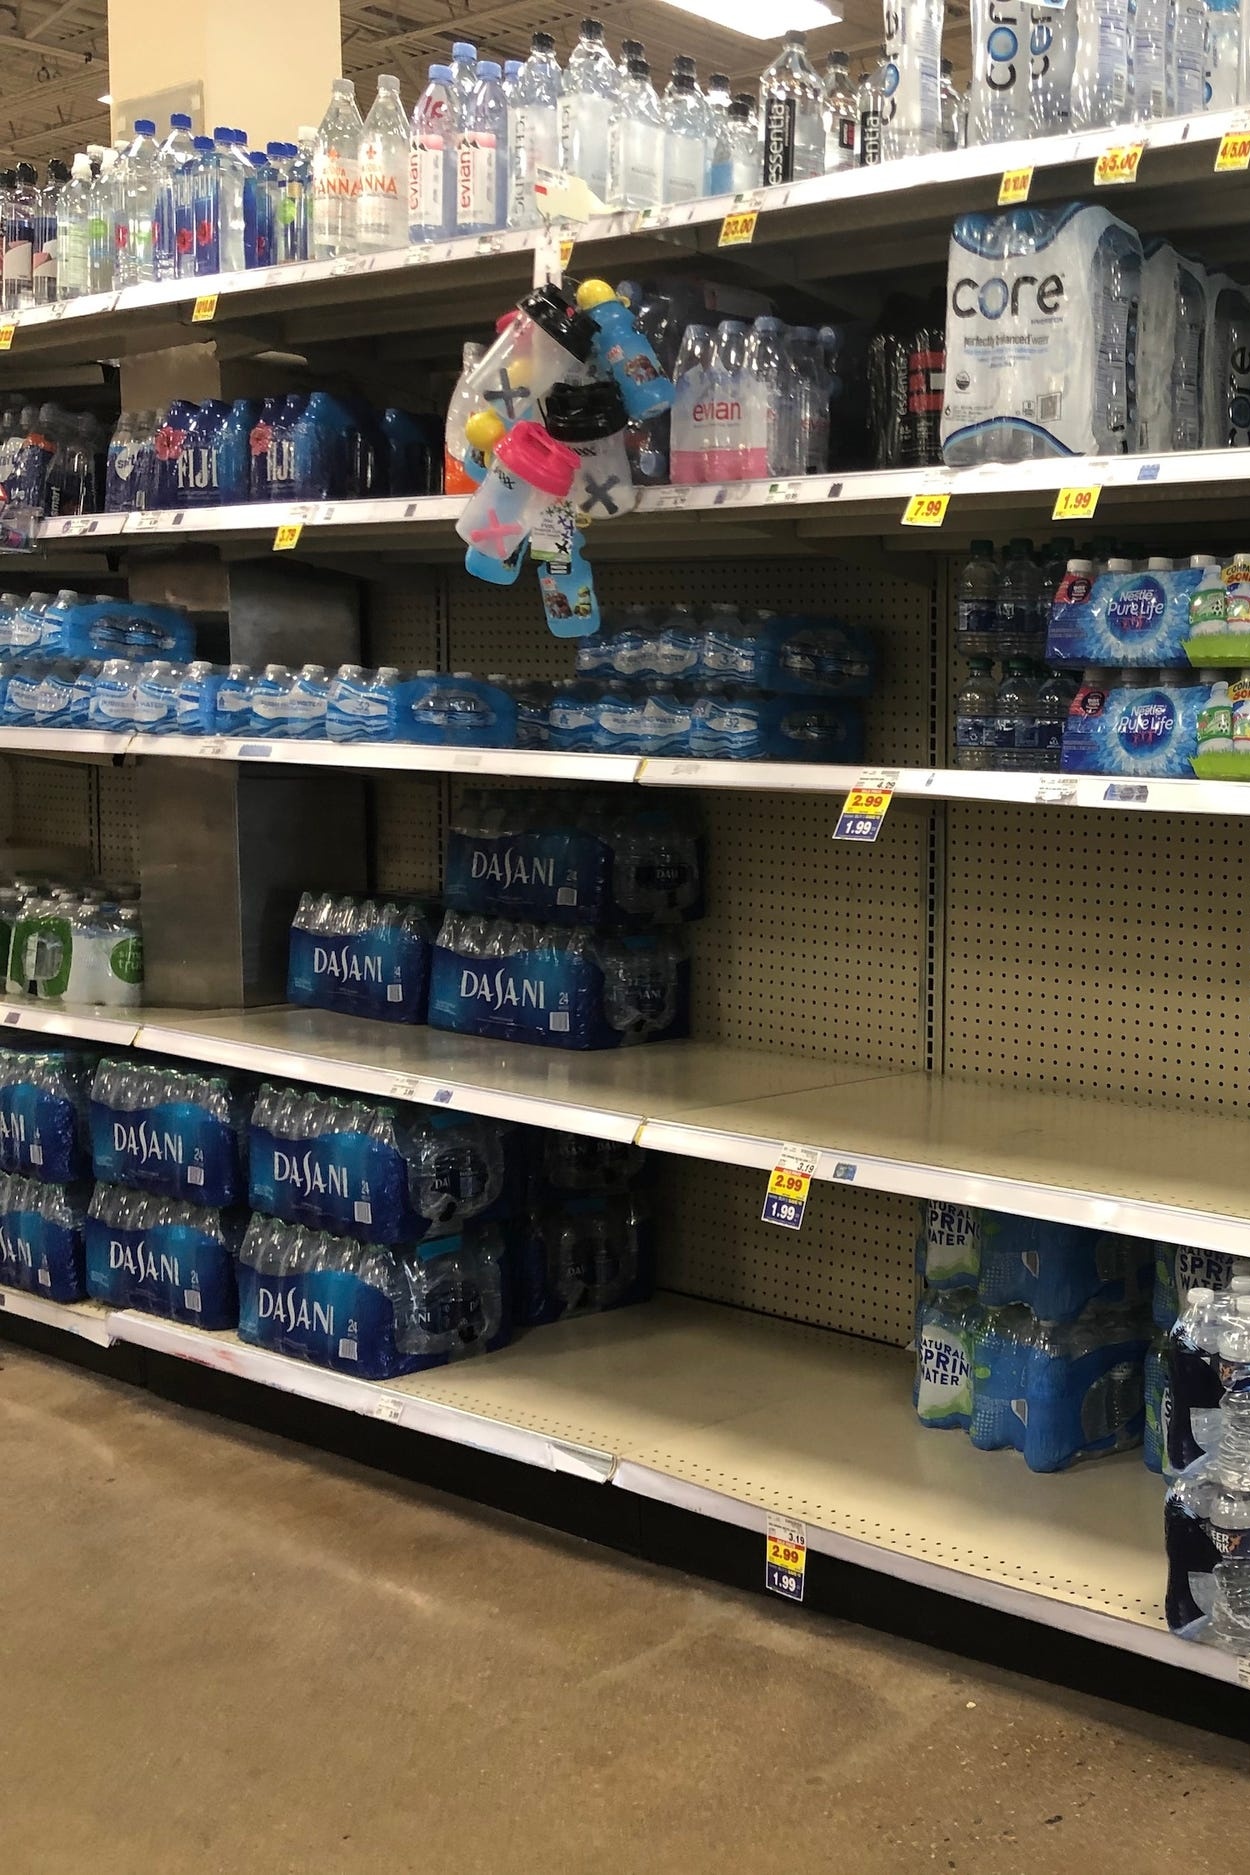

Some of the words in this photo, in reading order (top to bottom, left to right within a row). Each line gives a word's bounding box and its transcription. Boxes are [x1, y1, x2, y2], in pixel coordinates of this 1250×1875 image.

[768, 104, 785, 186] essentia
[1220, 140, 1250, 159] 4/5.00
[1098, 152, 1137, 172] 3/5.00
[460, 151, 471, 208] evian
[952, 274, 1065, 320] core
[692, 398, 741, 422] evian
[177, 448, 219, 488] FIJI
[914, 501, 942, 517] 7.99
[1064, 493, 1092, 510] 1.99
[1107, 603, 1139, 618] Pure
[1140, 602, 1164, 620] Life
[1119, 718, 1150, 733] Pure
[1151, 716, 1174, 735] Life
[852, 795, 883, 807] 2.99
[845, 820, 872, 835] 1.99
[471, 847, 554, 889] DASANI
[566, 869, 578, 881] 24
[313, 945, 383, 984] DASANI
[460, 967, 545, 1011] DASANI
[559, 992, 569, 1005] 24
[114, 1120, 184, 1164] DASANI
[274, 1150, 348, 1198] DASANI
[797, 1162, 815, 1173] 3.19
[361, 1179, 370, 1194] 24
[775, 1174, 803, 1192] 2.99
[771, 1202, 795, 1220] 1.99
[110, 1240, 180, 1287] DASANI
[1180, 1254, 1232, 1282] SPRI
[1180, 1274, 1222, 1292] WATE
[259, 1286, 334, 1336] DASANI
[347, 1318, 358, 1332] 24
[789, 1532, 805, 1545] 3.19
[772, 1545, 799, 1563] 2.99
[773, 1571, 796, 1592] 1.99
